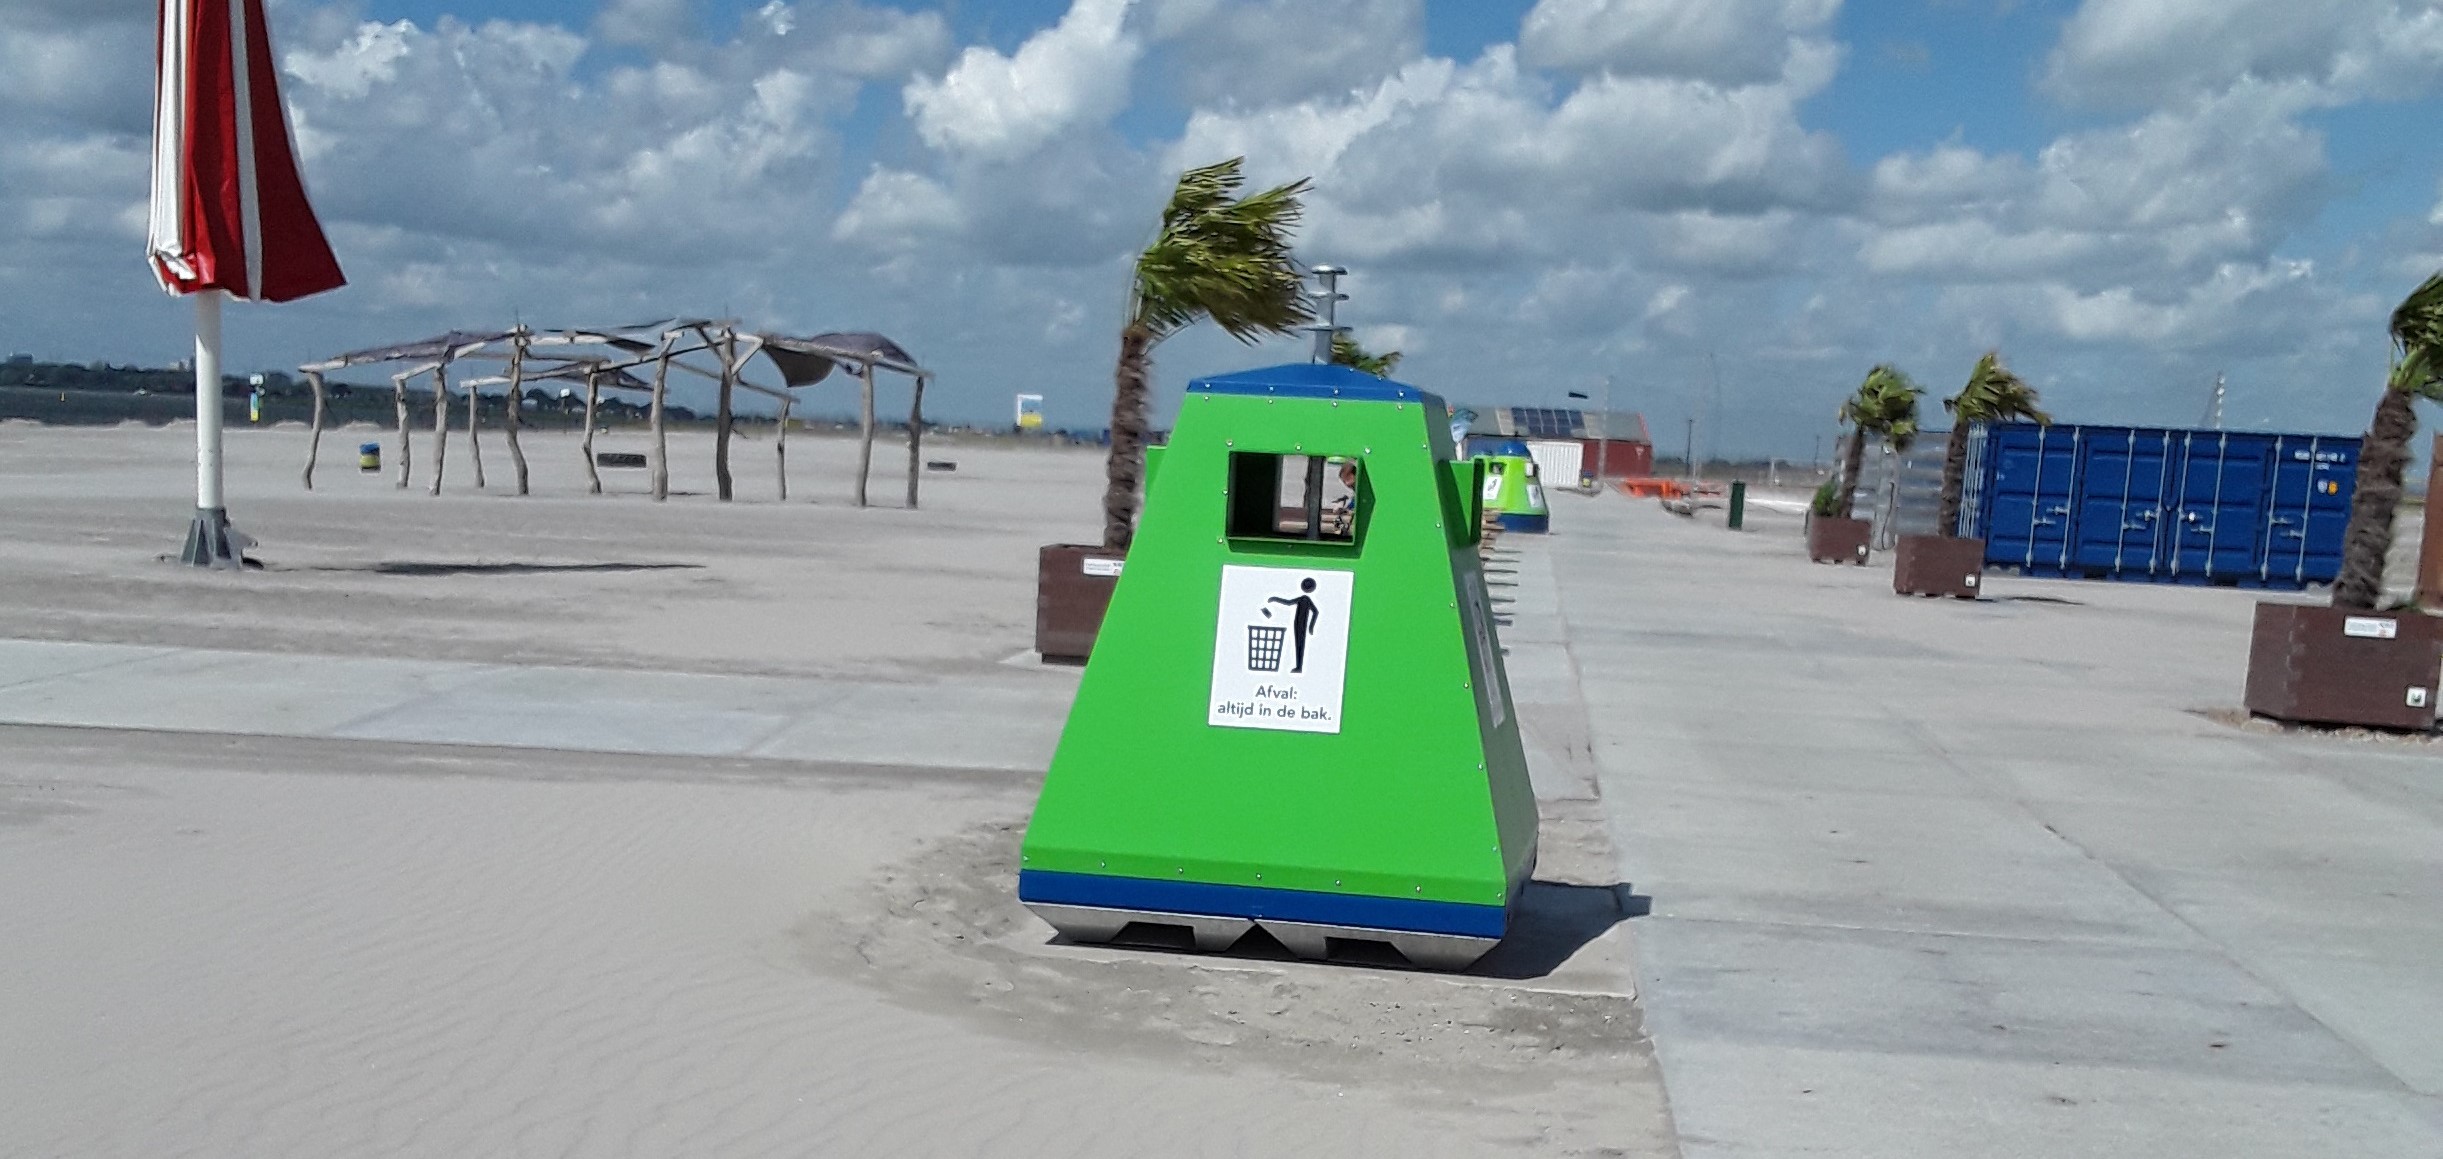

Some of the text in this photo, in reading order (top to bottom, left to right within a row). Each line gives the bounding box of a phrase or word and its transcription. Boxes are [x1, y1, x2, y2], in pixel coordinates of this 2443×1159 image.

[1255, 685, 1297, 699] Afval:
[1217, 701, 1331, 720] altijd in de bak.
